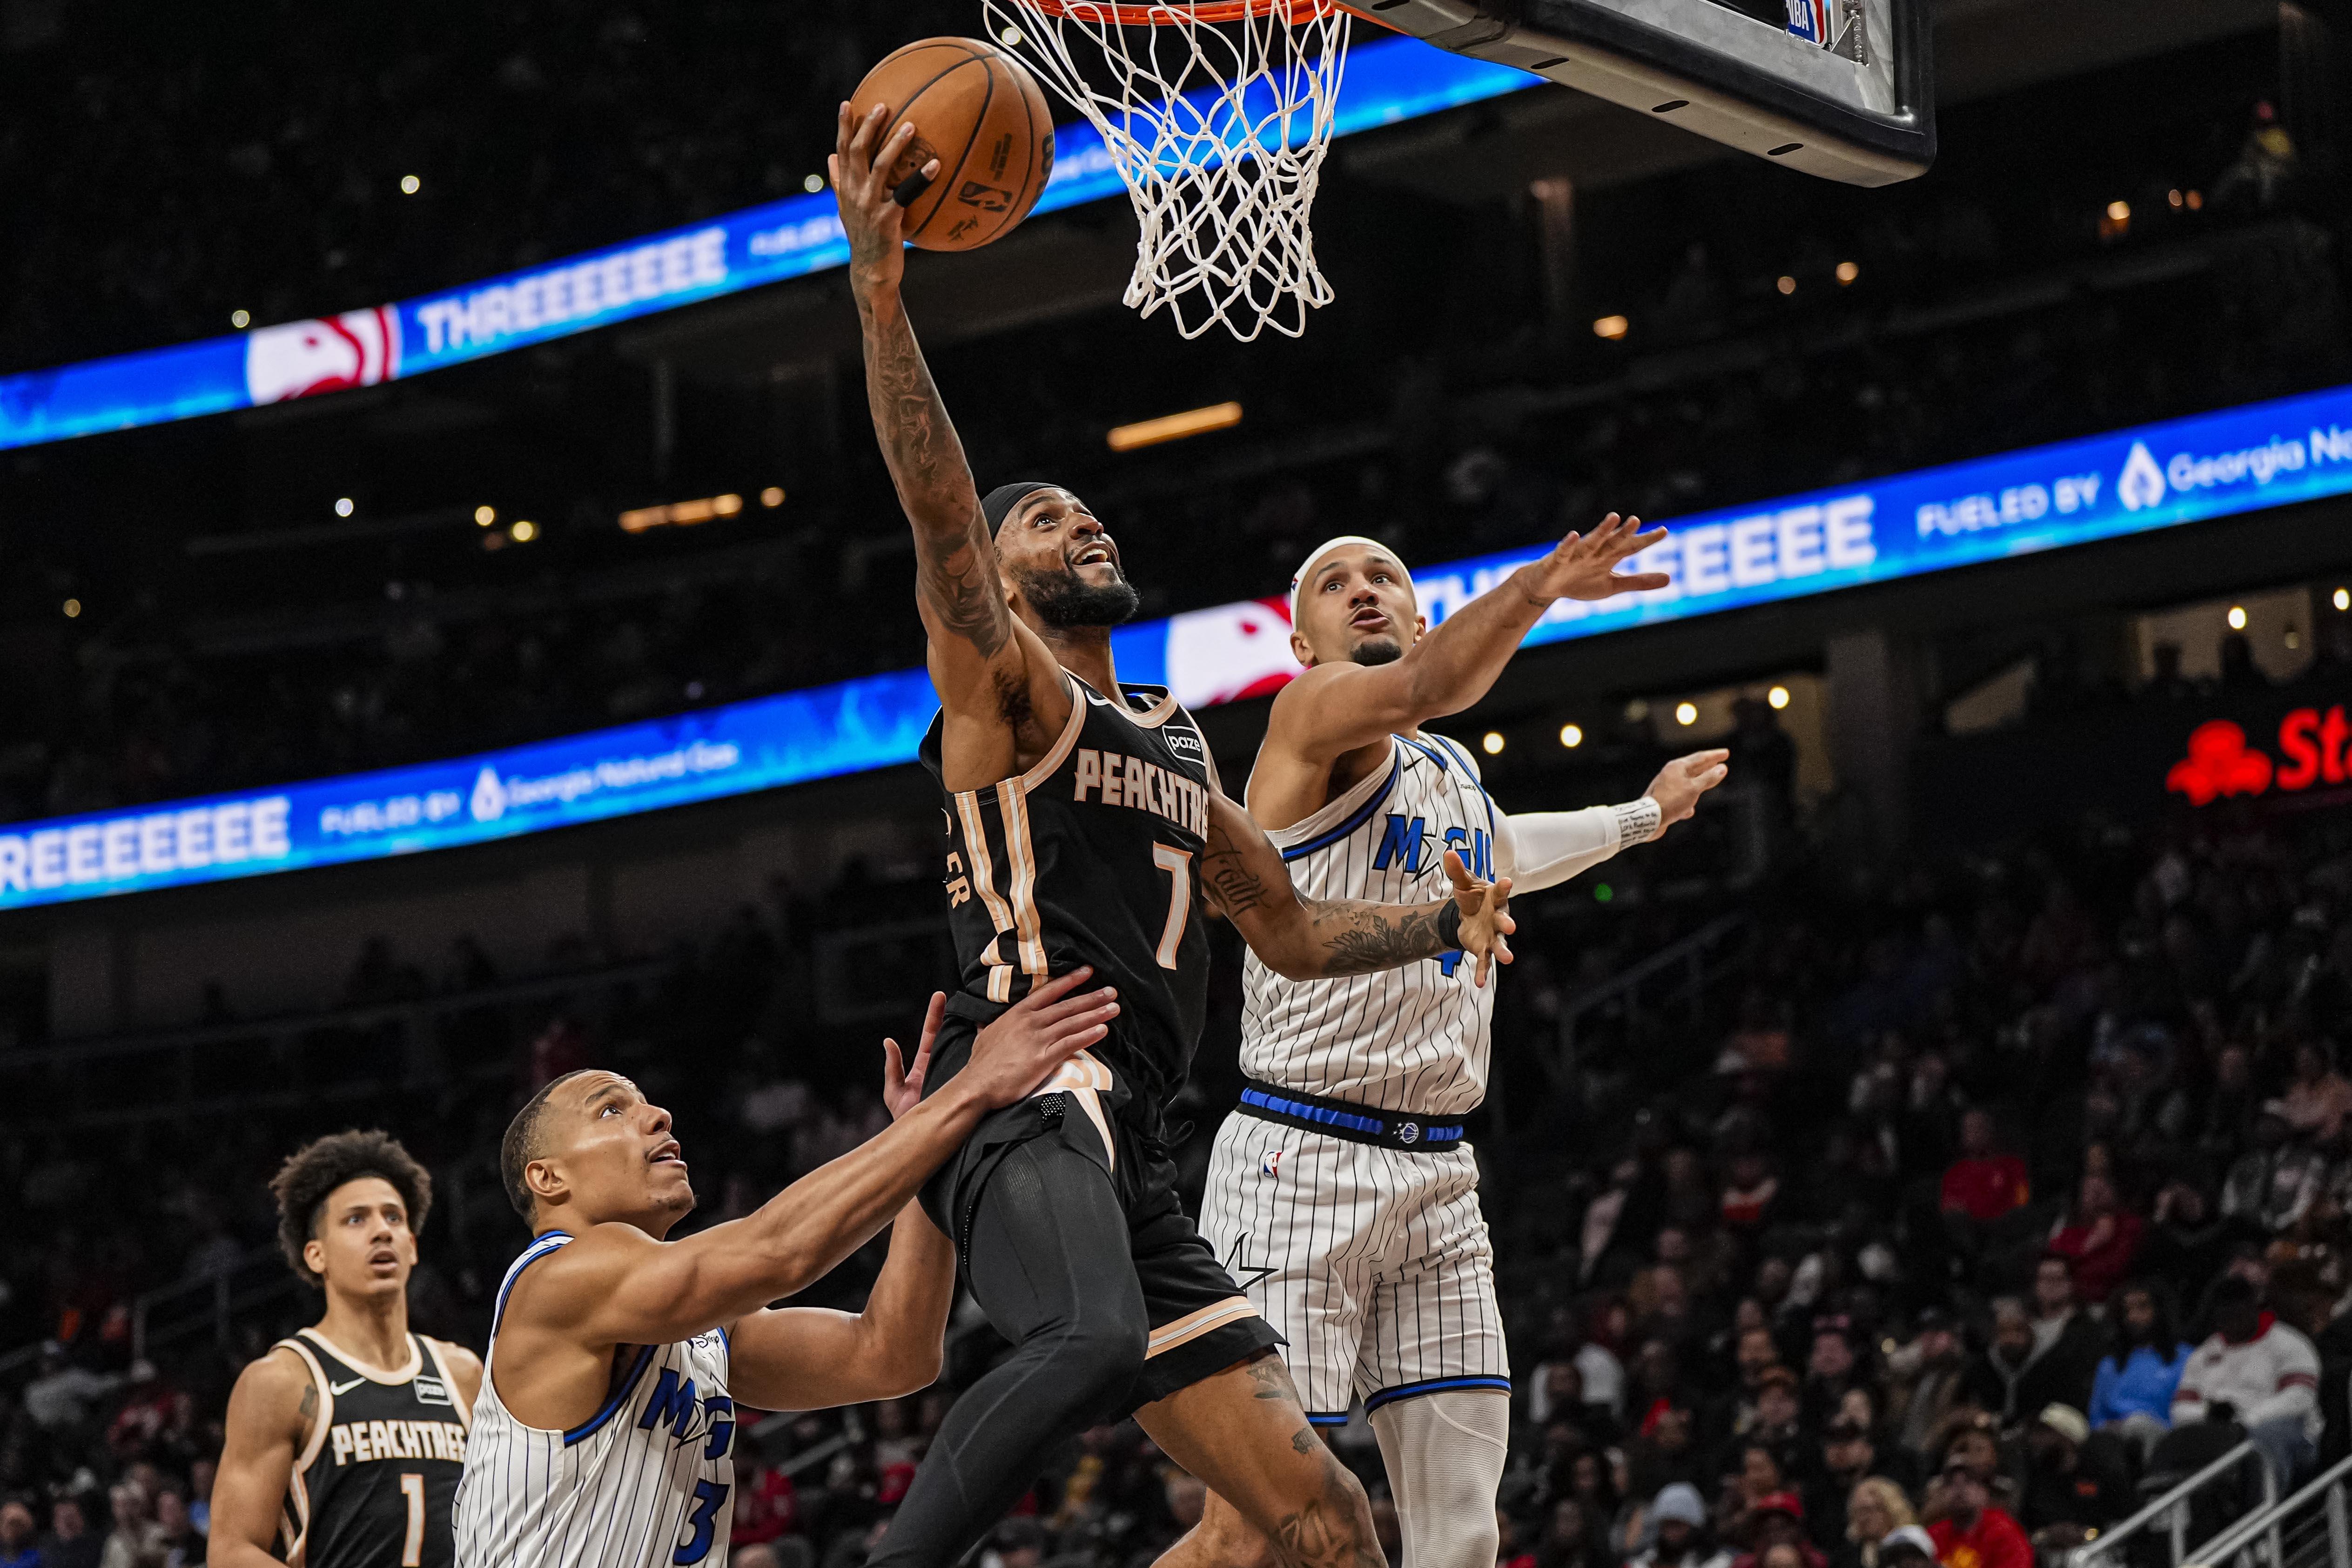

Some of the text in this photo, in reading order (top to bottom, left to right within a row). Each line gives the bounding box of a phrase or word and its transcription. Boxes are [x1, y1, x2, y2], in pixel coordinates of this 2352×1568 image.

[1786, 0, 1809, 31] NBA
[1916, 484, 2049, 538] FUELED
[2053, 472, 2100, 514] BY
[2167, 435, 2305, 491] Georgia
[320, 795, 421, 833] FUELED
[424, 791, 460, 822] BY
[507, 770, 594, 806] Georgia
[595, 750, 685, 787] Natural
[686, 740, 739, 772] Gas
[1168, 736, 1201, 752] paze
[2276, 704, 2352, 790] St
[1153, 841, 1193, 970] 7
[331, 1420, 466, 1467] PEACHTREE
[401, 1473, 425, 1567] 1
[673, 1478, 730, 1566] 3
